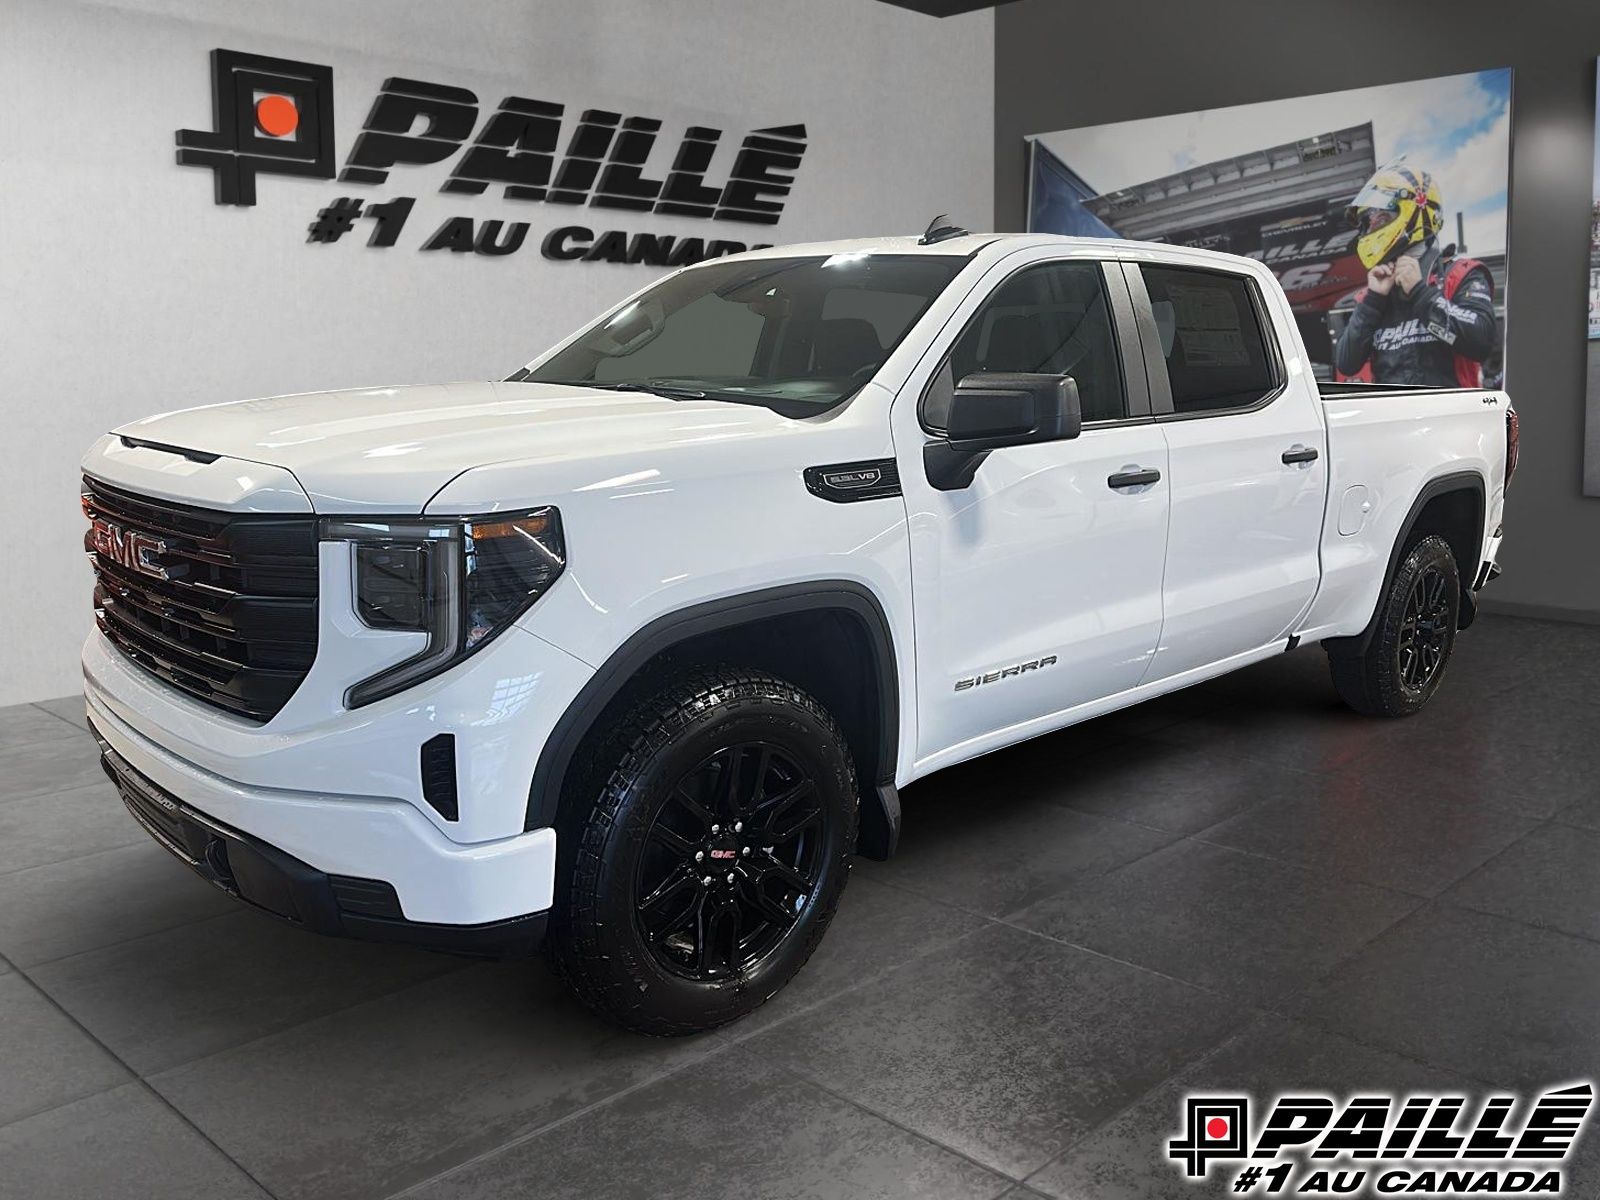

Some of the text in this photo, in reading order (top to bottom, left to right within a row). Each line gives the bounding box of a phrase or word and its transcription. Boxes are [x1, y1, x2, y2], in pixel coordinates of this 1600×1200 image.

[337, 76, 807, 225] PAILLÉ
[306, 196, 775, 267] #1 AU CANAD
[92, 521, 170, 582] GMC
[954, 655, 1058, 692] SIERRA
[710, 849, 736, 859] GMC
